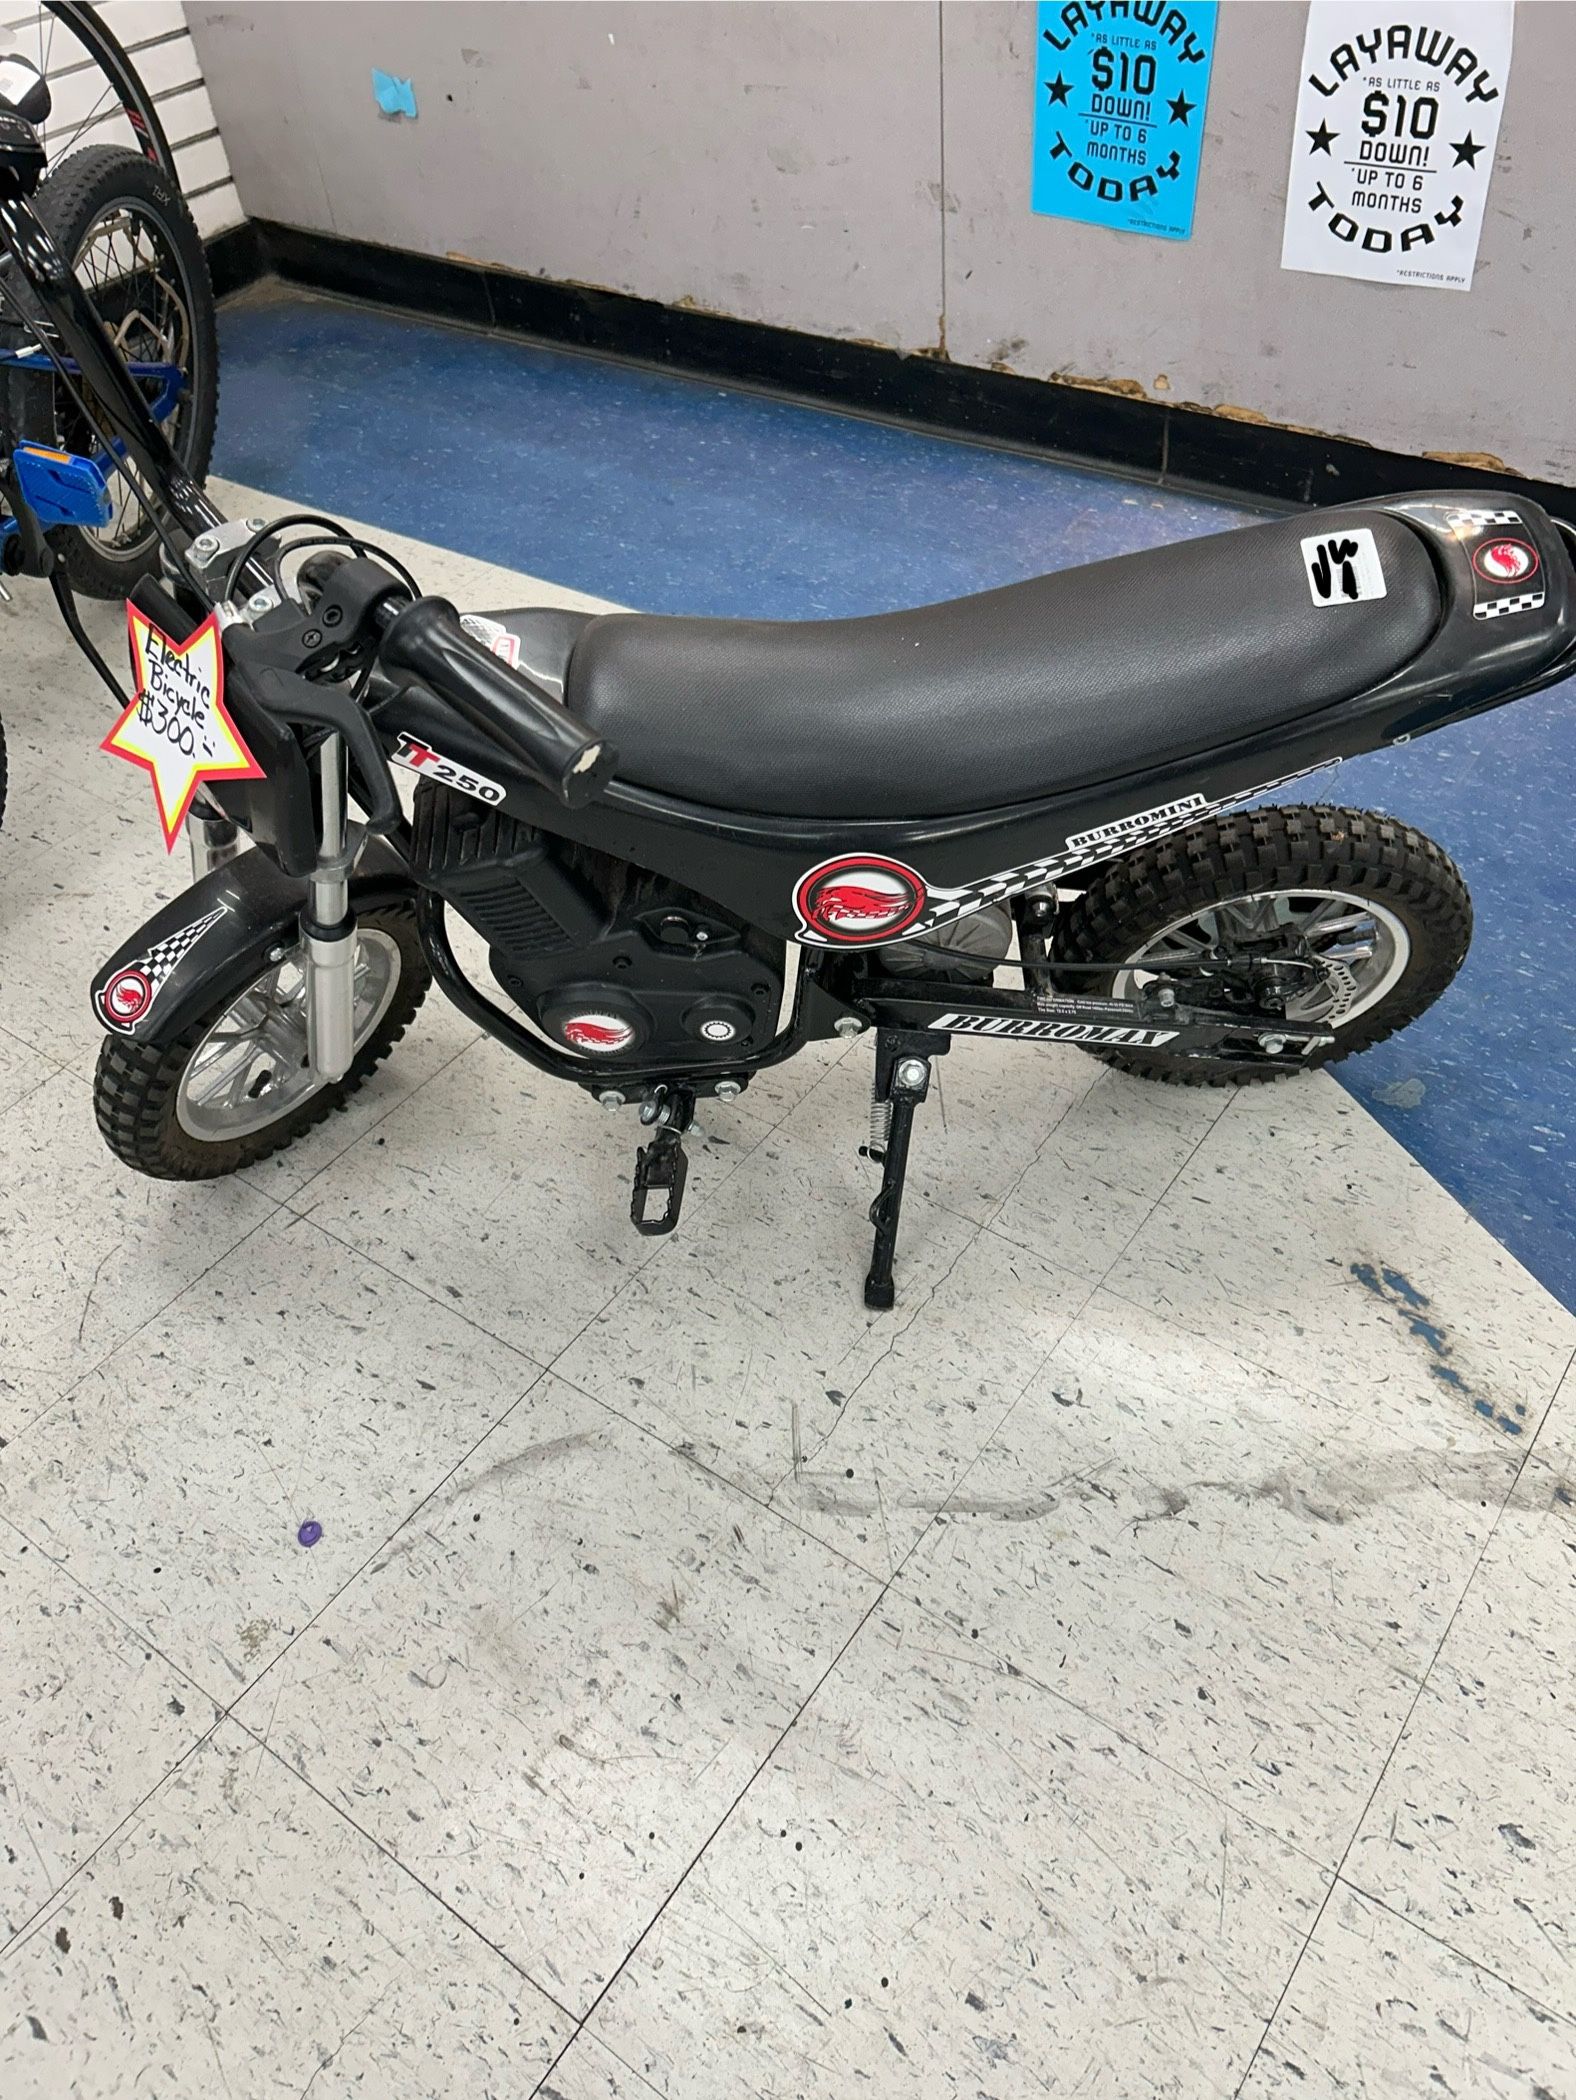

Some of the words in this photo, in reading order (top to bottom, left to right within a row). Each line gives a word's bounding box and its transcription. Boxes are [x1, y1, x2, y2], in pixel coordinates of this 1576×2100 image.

[1112, 36, 1140, 49] LITTLE
[1144, 39, 1157, 50] AS
[1091, 46, 1157, 95] $10
[1308, 24, 1499, 103] LAYAWAY
[1387, 78, 1421, 91] LITTLE
[1426, 81, 1440, 92] AS
[1091, 93, 1150, 120] DOWN!
[1361, 90, 1439, 139] $10
[1114, 124, 1132, 142] TO
[1137, 128, 1147, 144] 6
[1050, 131, 1181, 202] TODAY
[1086, 141, 1147, 166] MONTHS
[1359, 140, 1430, 166] DOWN!
[1385, 171, 1405, 188] TO
[1412, 175, 1424, 191] 6
[1308, 181, 1464, 253] TODAY
[1352, 190, 1423, 214] MONTHS
[145, 622, 210, 710] Electric
[148, 658, 205, 730] Bicycle
[1071, 797, 1205, 848] BURROMINI
[942, 1015, 1165, 1045] BURROMAX
